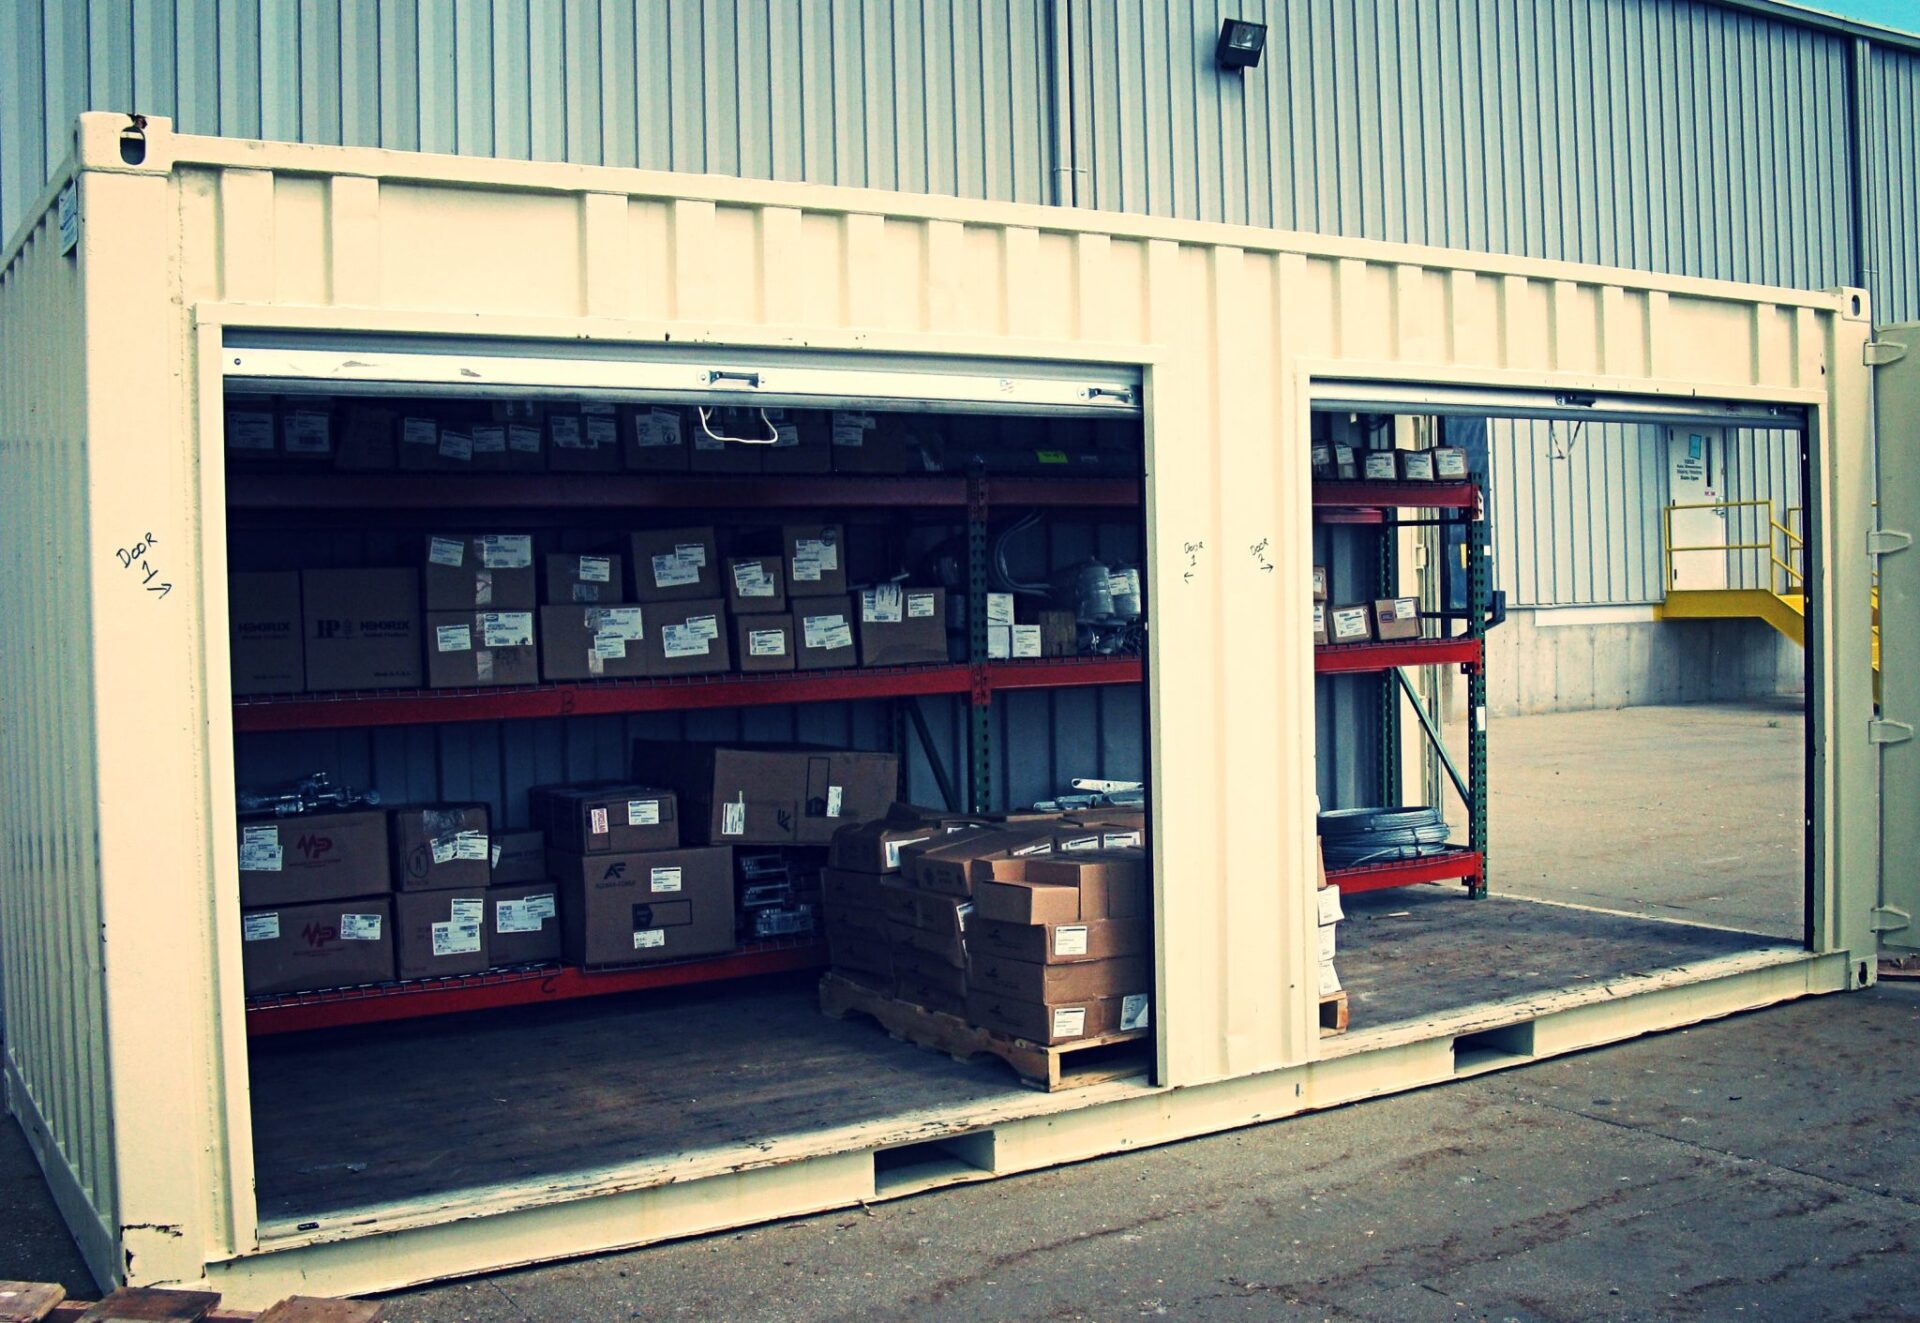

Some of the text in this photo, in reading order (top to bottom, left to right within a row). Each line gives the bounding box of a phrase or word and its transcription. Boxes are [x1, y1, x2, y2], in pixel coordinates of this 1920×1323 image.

[141, 560, 159, 584] 1
[1189, 554, 1197, 567] 1
[560, 690, 576, 713] B
[296, 833, 333, 859] MP
[603, 862, 627, 880] AF
[301, 922, 336, 947] MP
[541, 976, 556, 994] C
